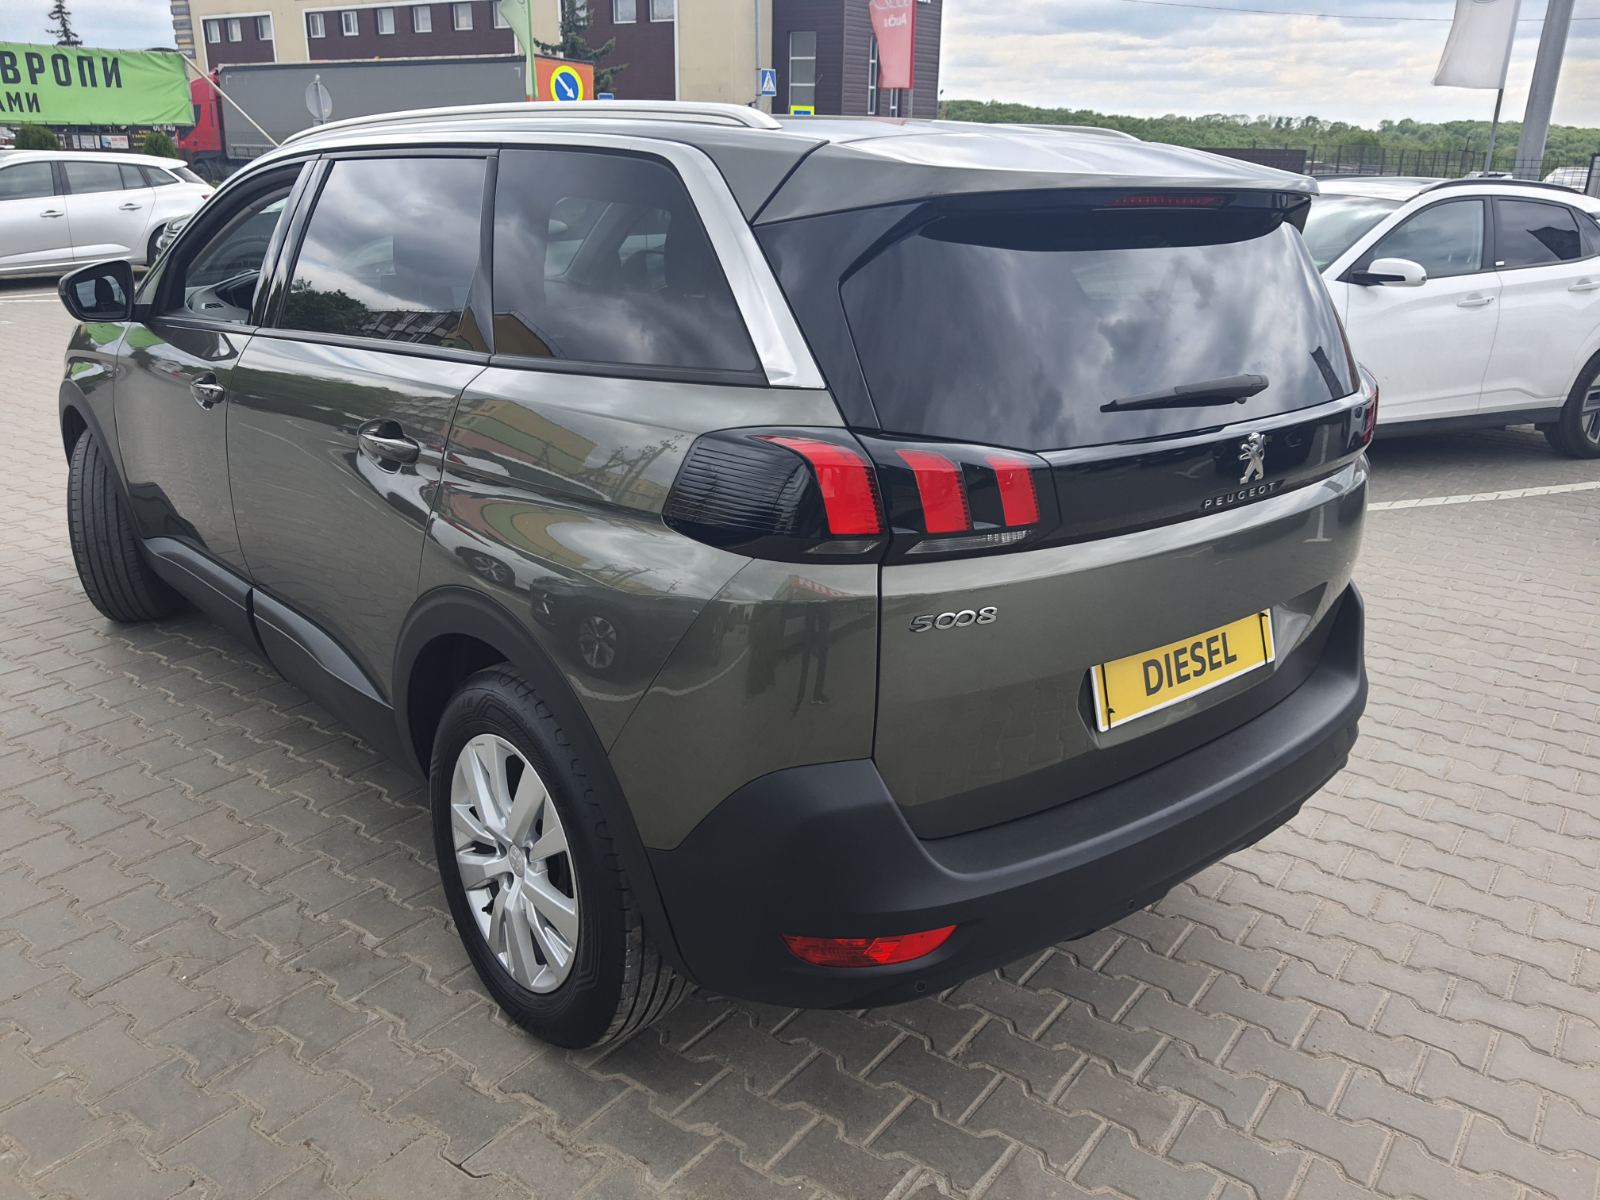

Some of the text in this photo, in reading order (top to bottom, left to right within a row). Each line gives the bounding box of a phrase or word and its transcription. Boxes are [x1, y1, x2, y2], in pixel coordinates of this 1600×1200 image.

[0, 91, 41, 113] МИ
[1204, 482, 1276, 509] PEUGEOT
[909, 606, 998, 633] 5008
[1142, 632, 1237, 697] DIESEL
